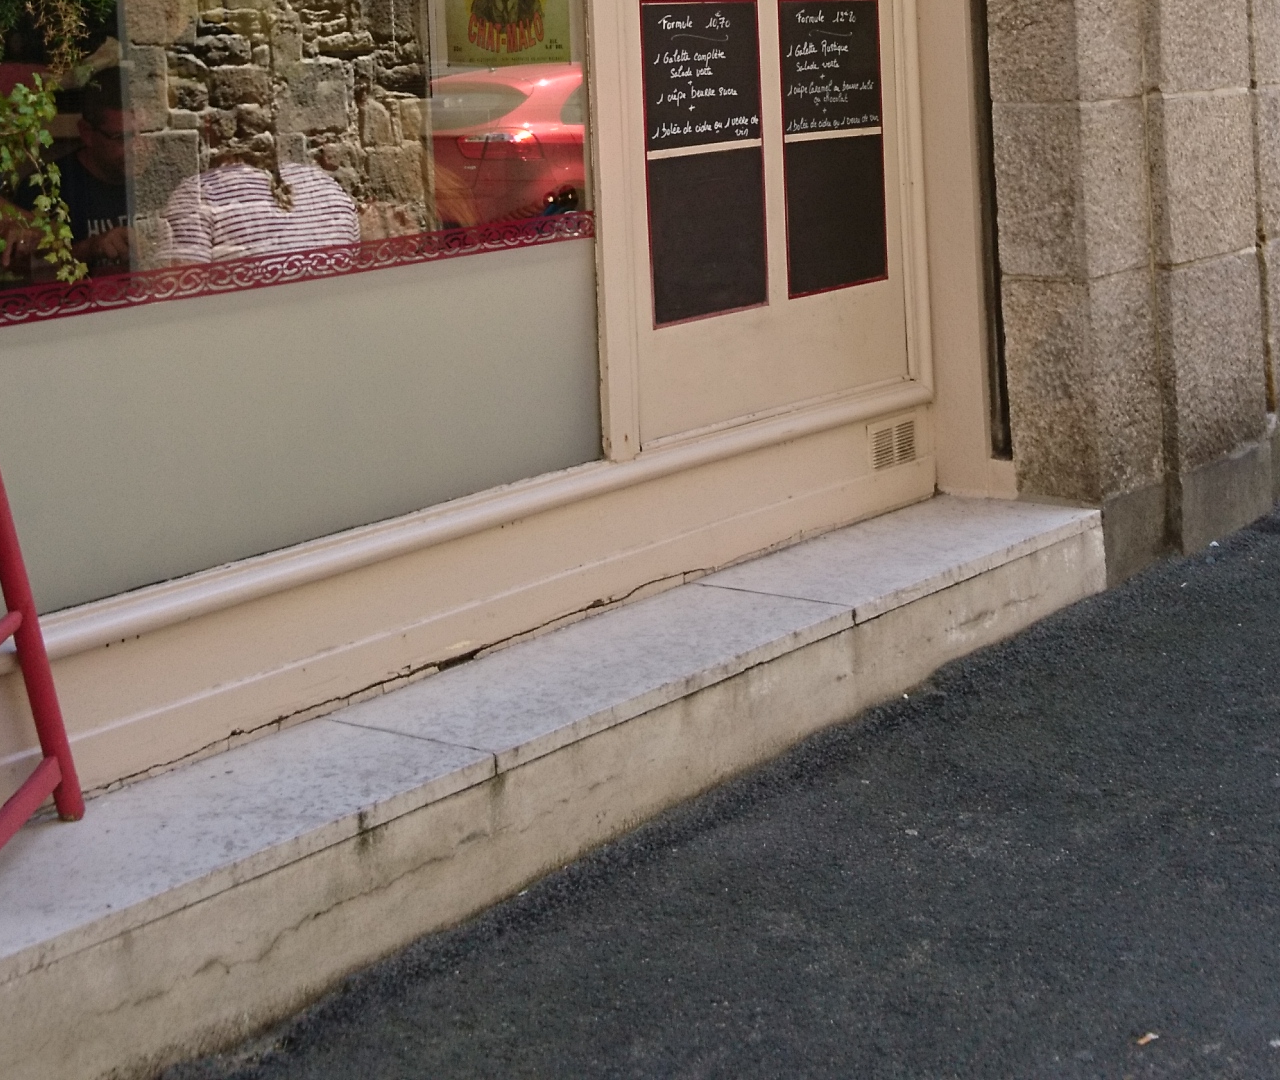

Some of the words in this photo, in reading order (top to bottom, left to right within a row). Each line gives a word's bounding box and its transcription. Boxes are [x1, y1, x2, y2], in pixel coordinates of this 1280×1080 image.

[657, 14, 693, 30] Formule
[795, 9, 825, 24] Formule
[467, 11, 545, 54] CHAT-MALO
[794, 41, 818, 58] Galette
[653, 53, 660, 65] 1
[663, 49, 691, 64] Galette
[693, 48, 727, 67] complète
[670, 65, 693, 79] Salade
[795, 60, 820, 72] Salade
[690, 85, 716, 99] beurre
[683, 121, 693, 134] de
[731, 115, 749, 126] verre
[734, 126, 749, 137] vin
